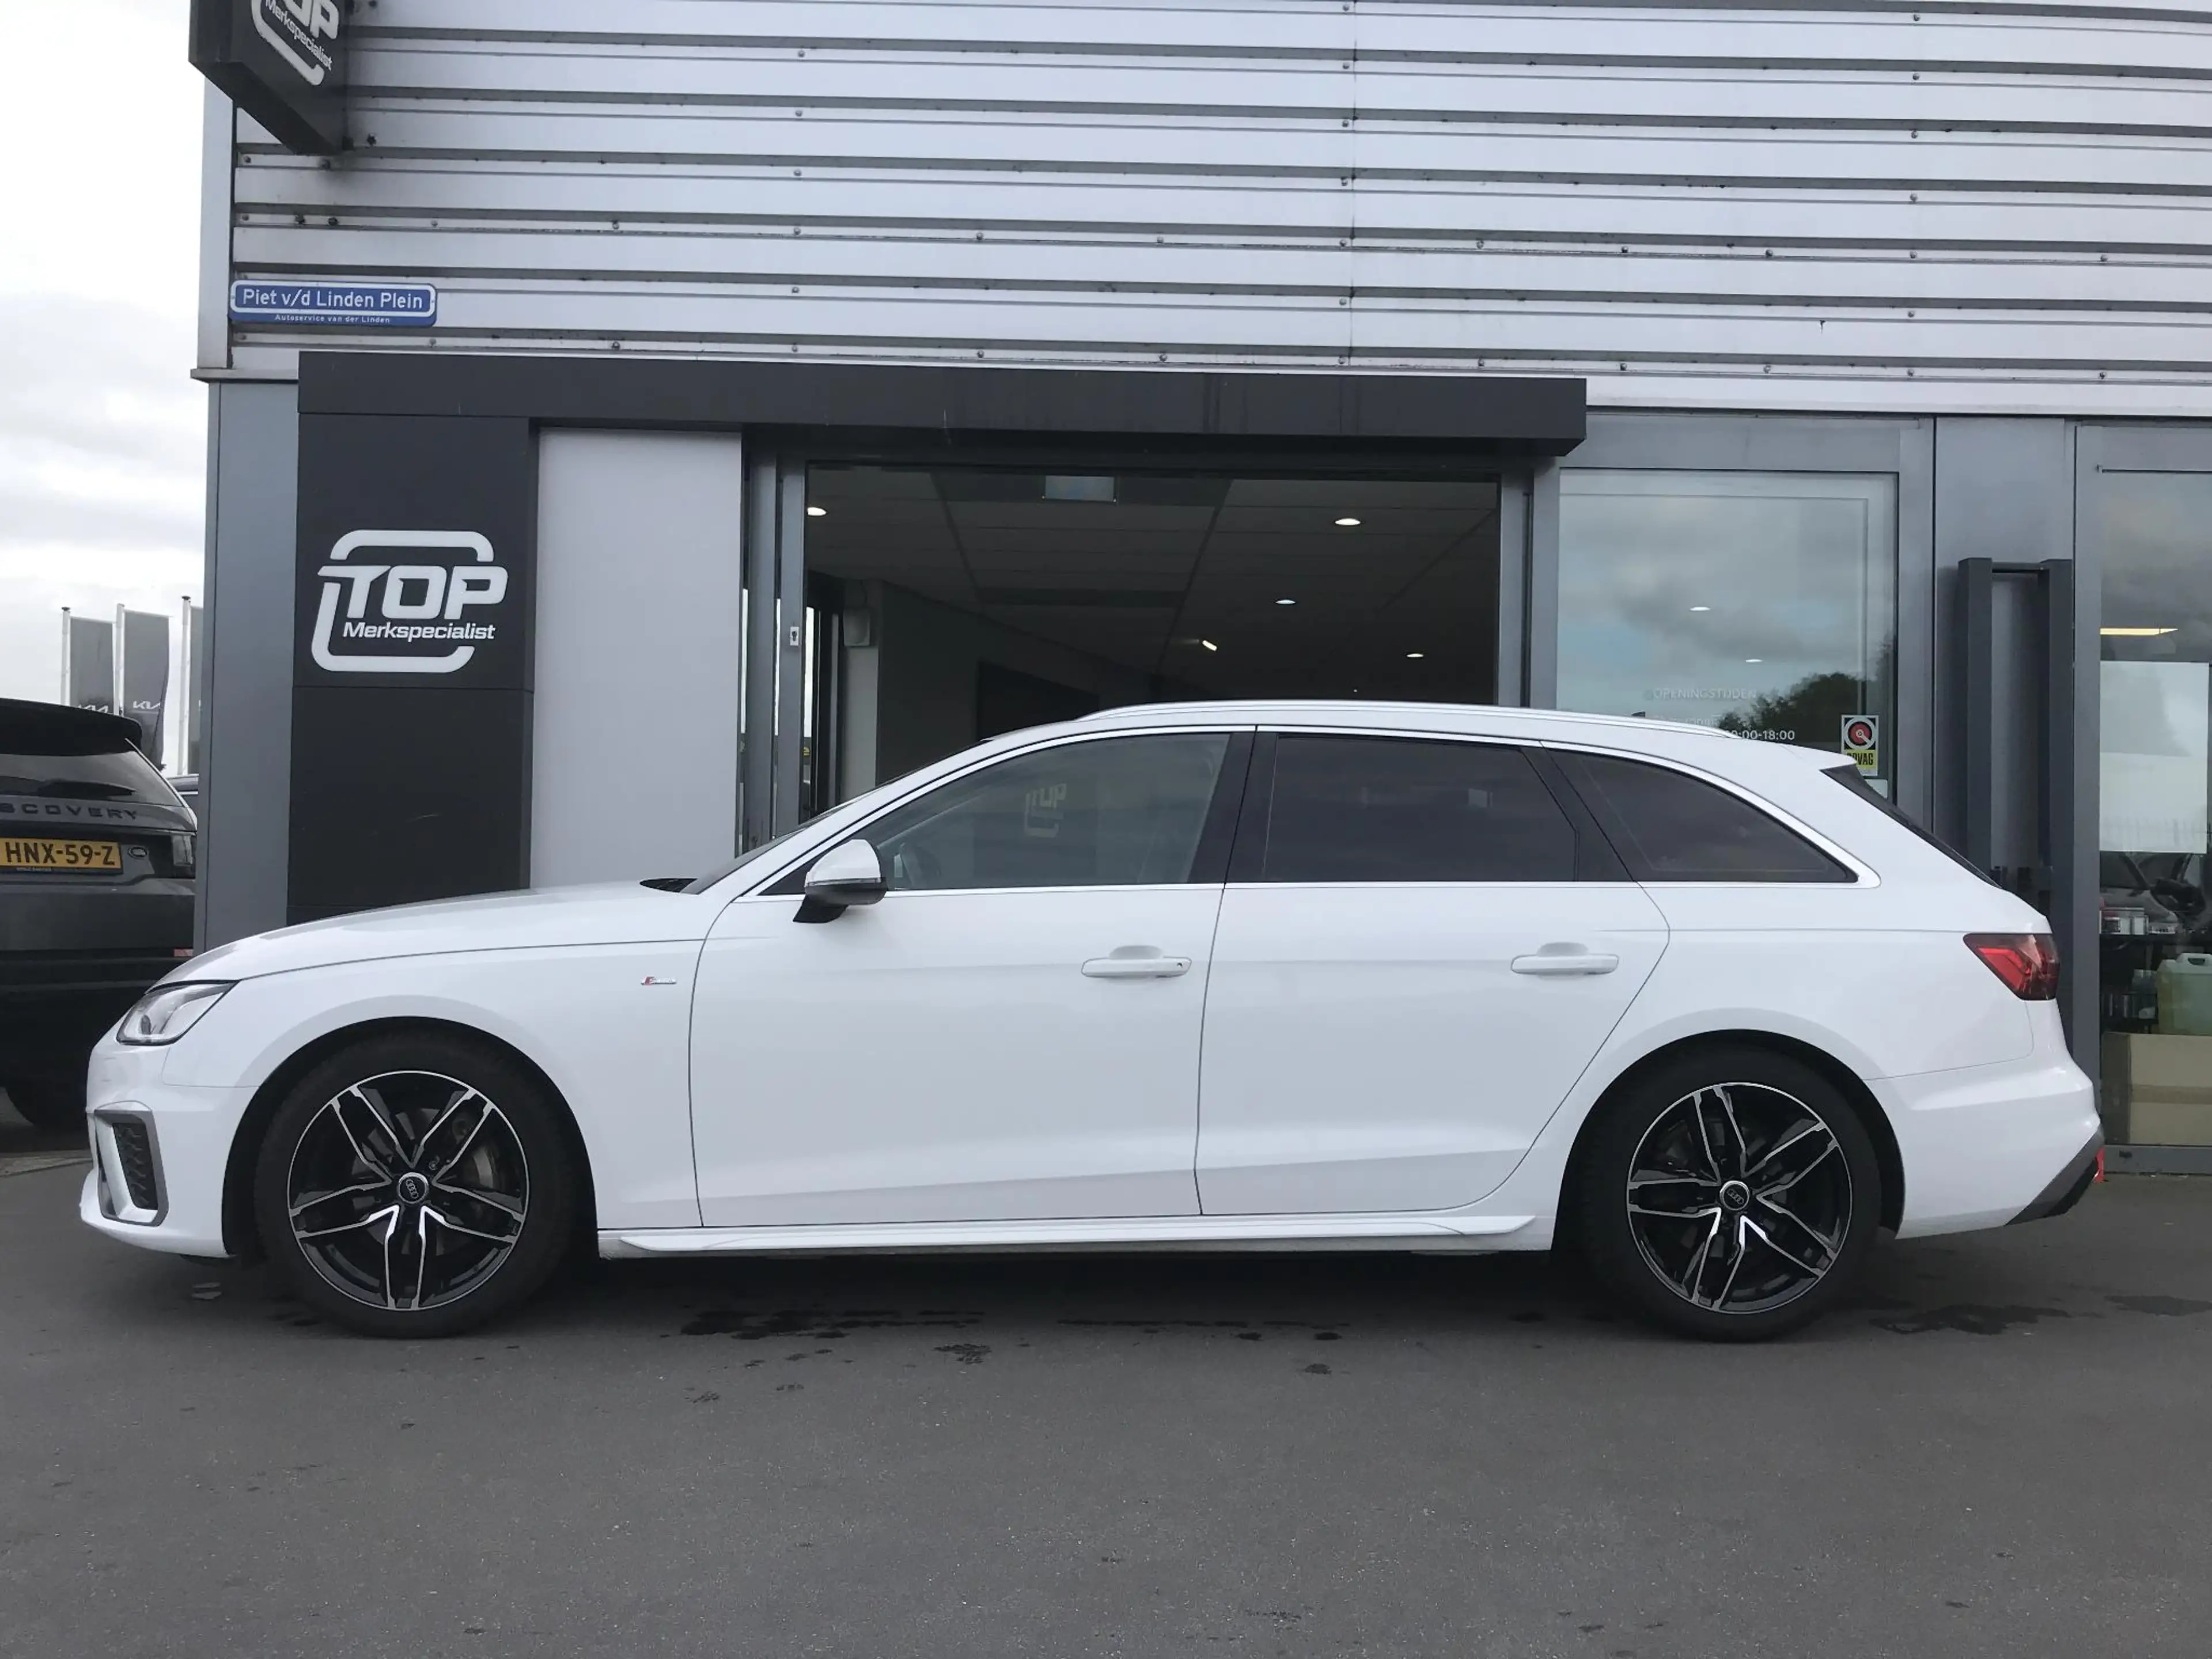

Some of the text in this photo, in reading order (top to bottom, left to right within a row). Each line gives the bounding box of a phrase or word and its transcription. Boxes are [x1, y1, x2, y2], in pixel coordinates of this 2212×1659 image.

[243, 289, 423, 309] Piet v/d Linden Plein
[275, 314, 324, 322] Autoservice
[317, 565, 508, 620] TOP
[343, 622, 495, 642] Merkspecialist
[5, 841, 115, 866] HNX-59-Z
